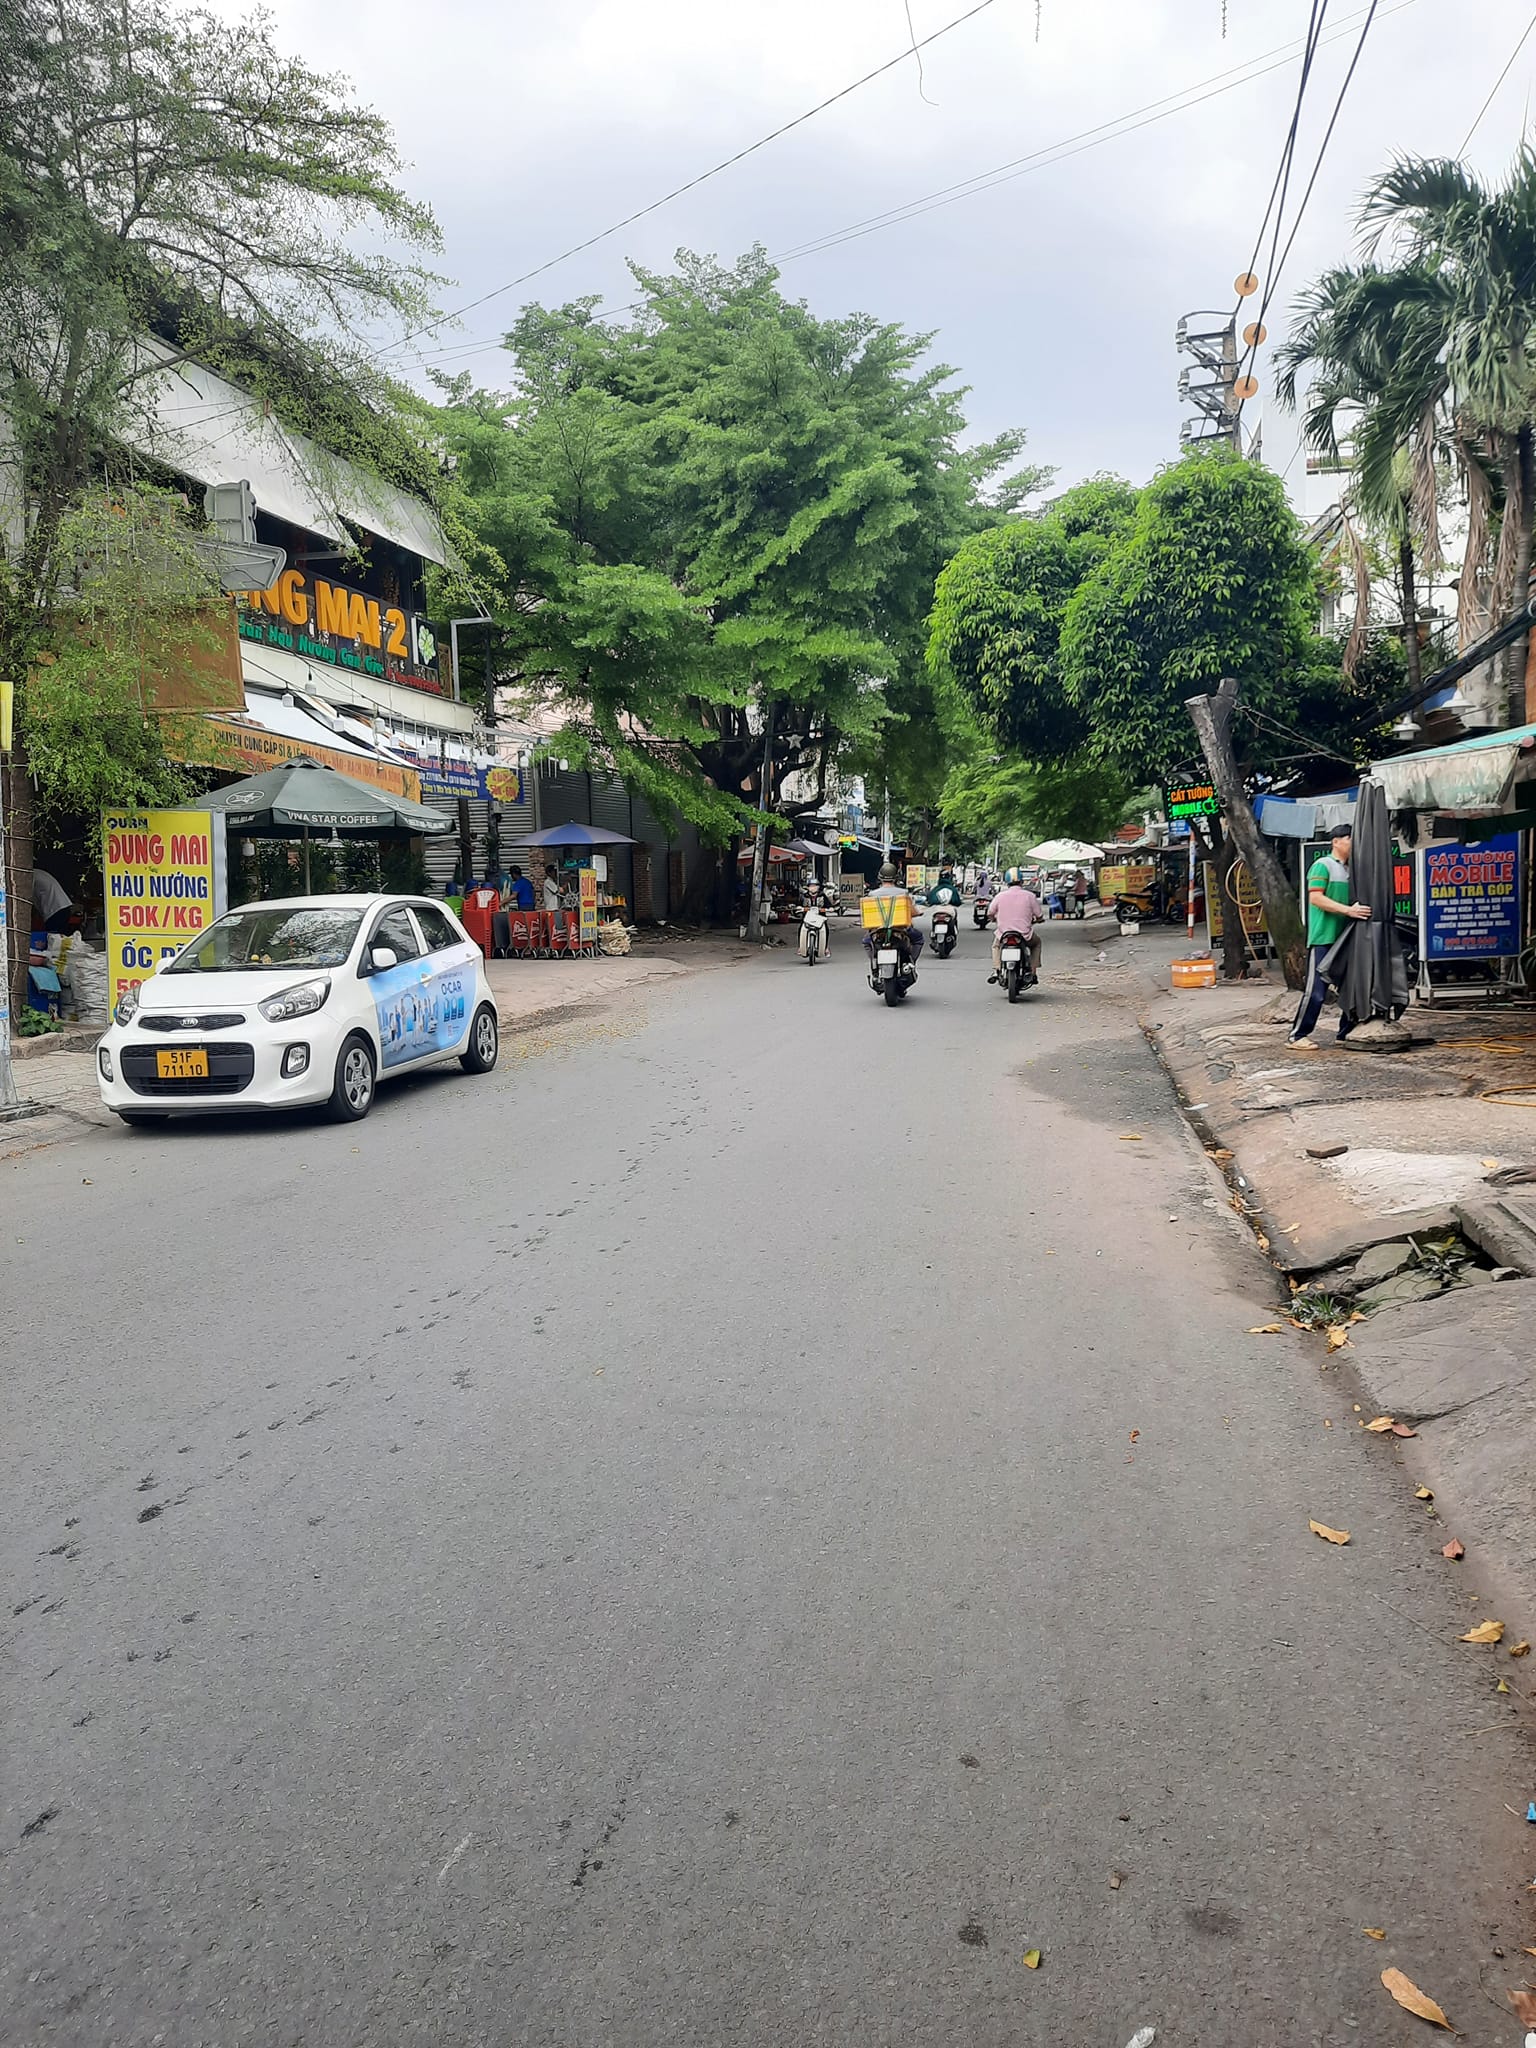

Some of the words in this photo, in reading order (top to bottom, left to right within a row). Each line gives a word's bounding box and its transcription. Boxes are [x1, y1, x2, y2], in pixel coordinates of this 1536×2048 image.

[315, 579, 380, 648] MAI
[386, 609, 408, 657] 2
[244, 735, 262, 752] CUNG
[311, 814, 337, 824] STAR
[340, 815, 378, 825] COFFEE
[172, 835, 207, 865] MAI
[1428, 853, 1458, 866] CÁT
[1462, 850, 1515, 864] TƯỜNG
[1430, 863, 1513, 886] MOBILE
[112, 870, 144, 897] HÀU
[150, 871, 207, 899] NƯỚNG
[122, 938, 152, 968] ỐC
[182, 1018, 198, 1026] KIA
[171, 1052, 192, 1063] 51F
[163, 1064, 203, 1076] 711.10
